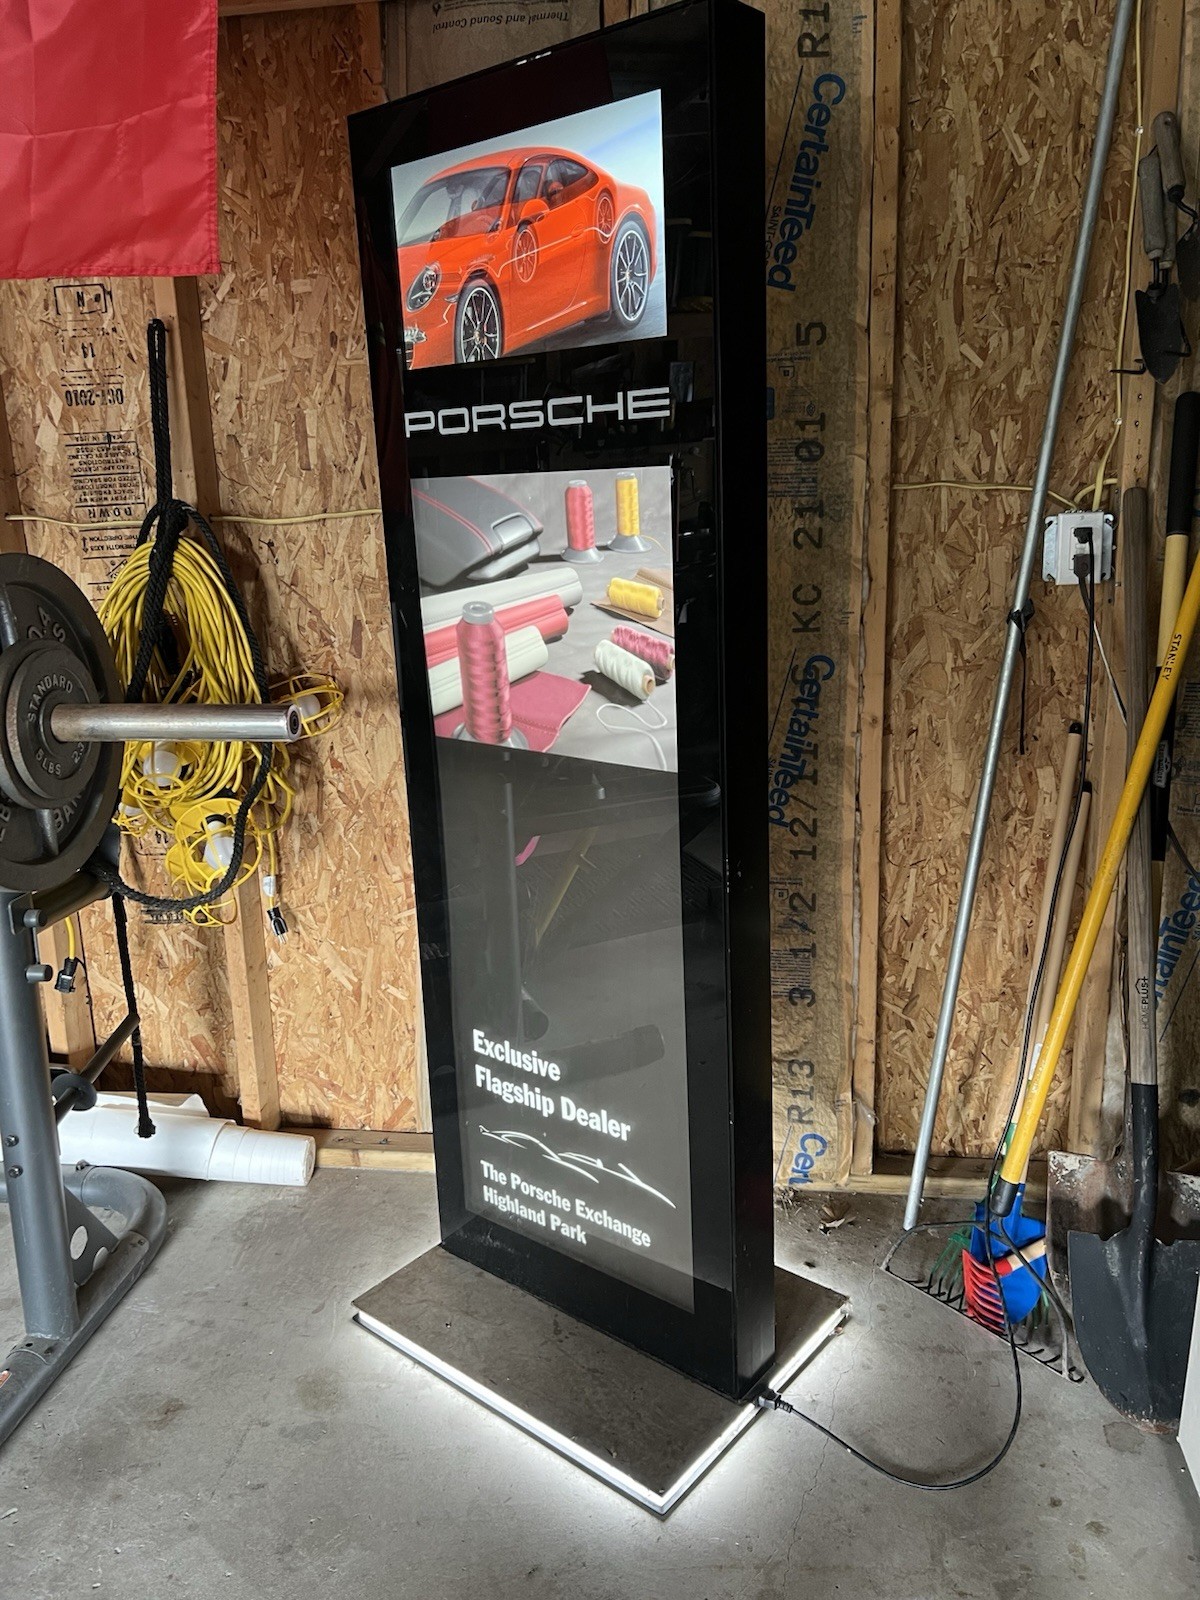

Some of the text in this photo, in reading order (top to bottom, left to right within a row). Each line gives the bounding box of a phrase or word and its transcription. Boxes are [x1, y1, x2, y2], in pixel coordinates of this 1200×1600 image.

[432, 12, 569, 33] Thermal and Sound Control
[766, 73, 846, 292] CertainTeed
[796, 321, 827, 347] 5
[404, 387, 671, 438] PORSCHE
[791, 583, 823, 634] KC
[1161, 633, 1183, 681] STANLEY
[27, 674, 73, 722] STANDARD
[768, 655, 836, 828] CertainTeed
[472, 1028, 561, 1082] Exclusive
[475, 1064, 632, 1142] Flagship Dealer
[787, 1058, 816, 1126] R13
[480, 1159, 652, 1248] The Porsche Exchange
[482, 1184, 588, 1246] Highland Park
